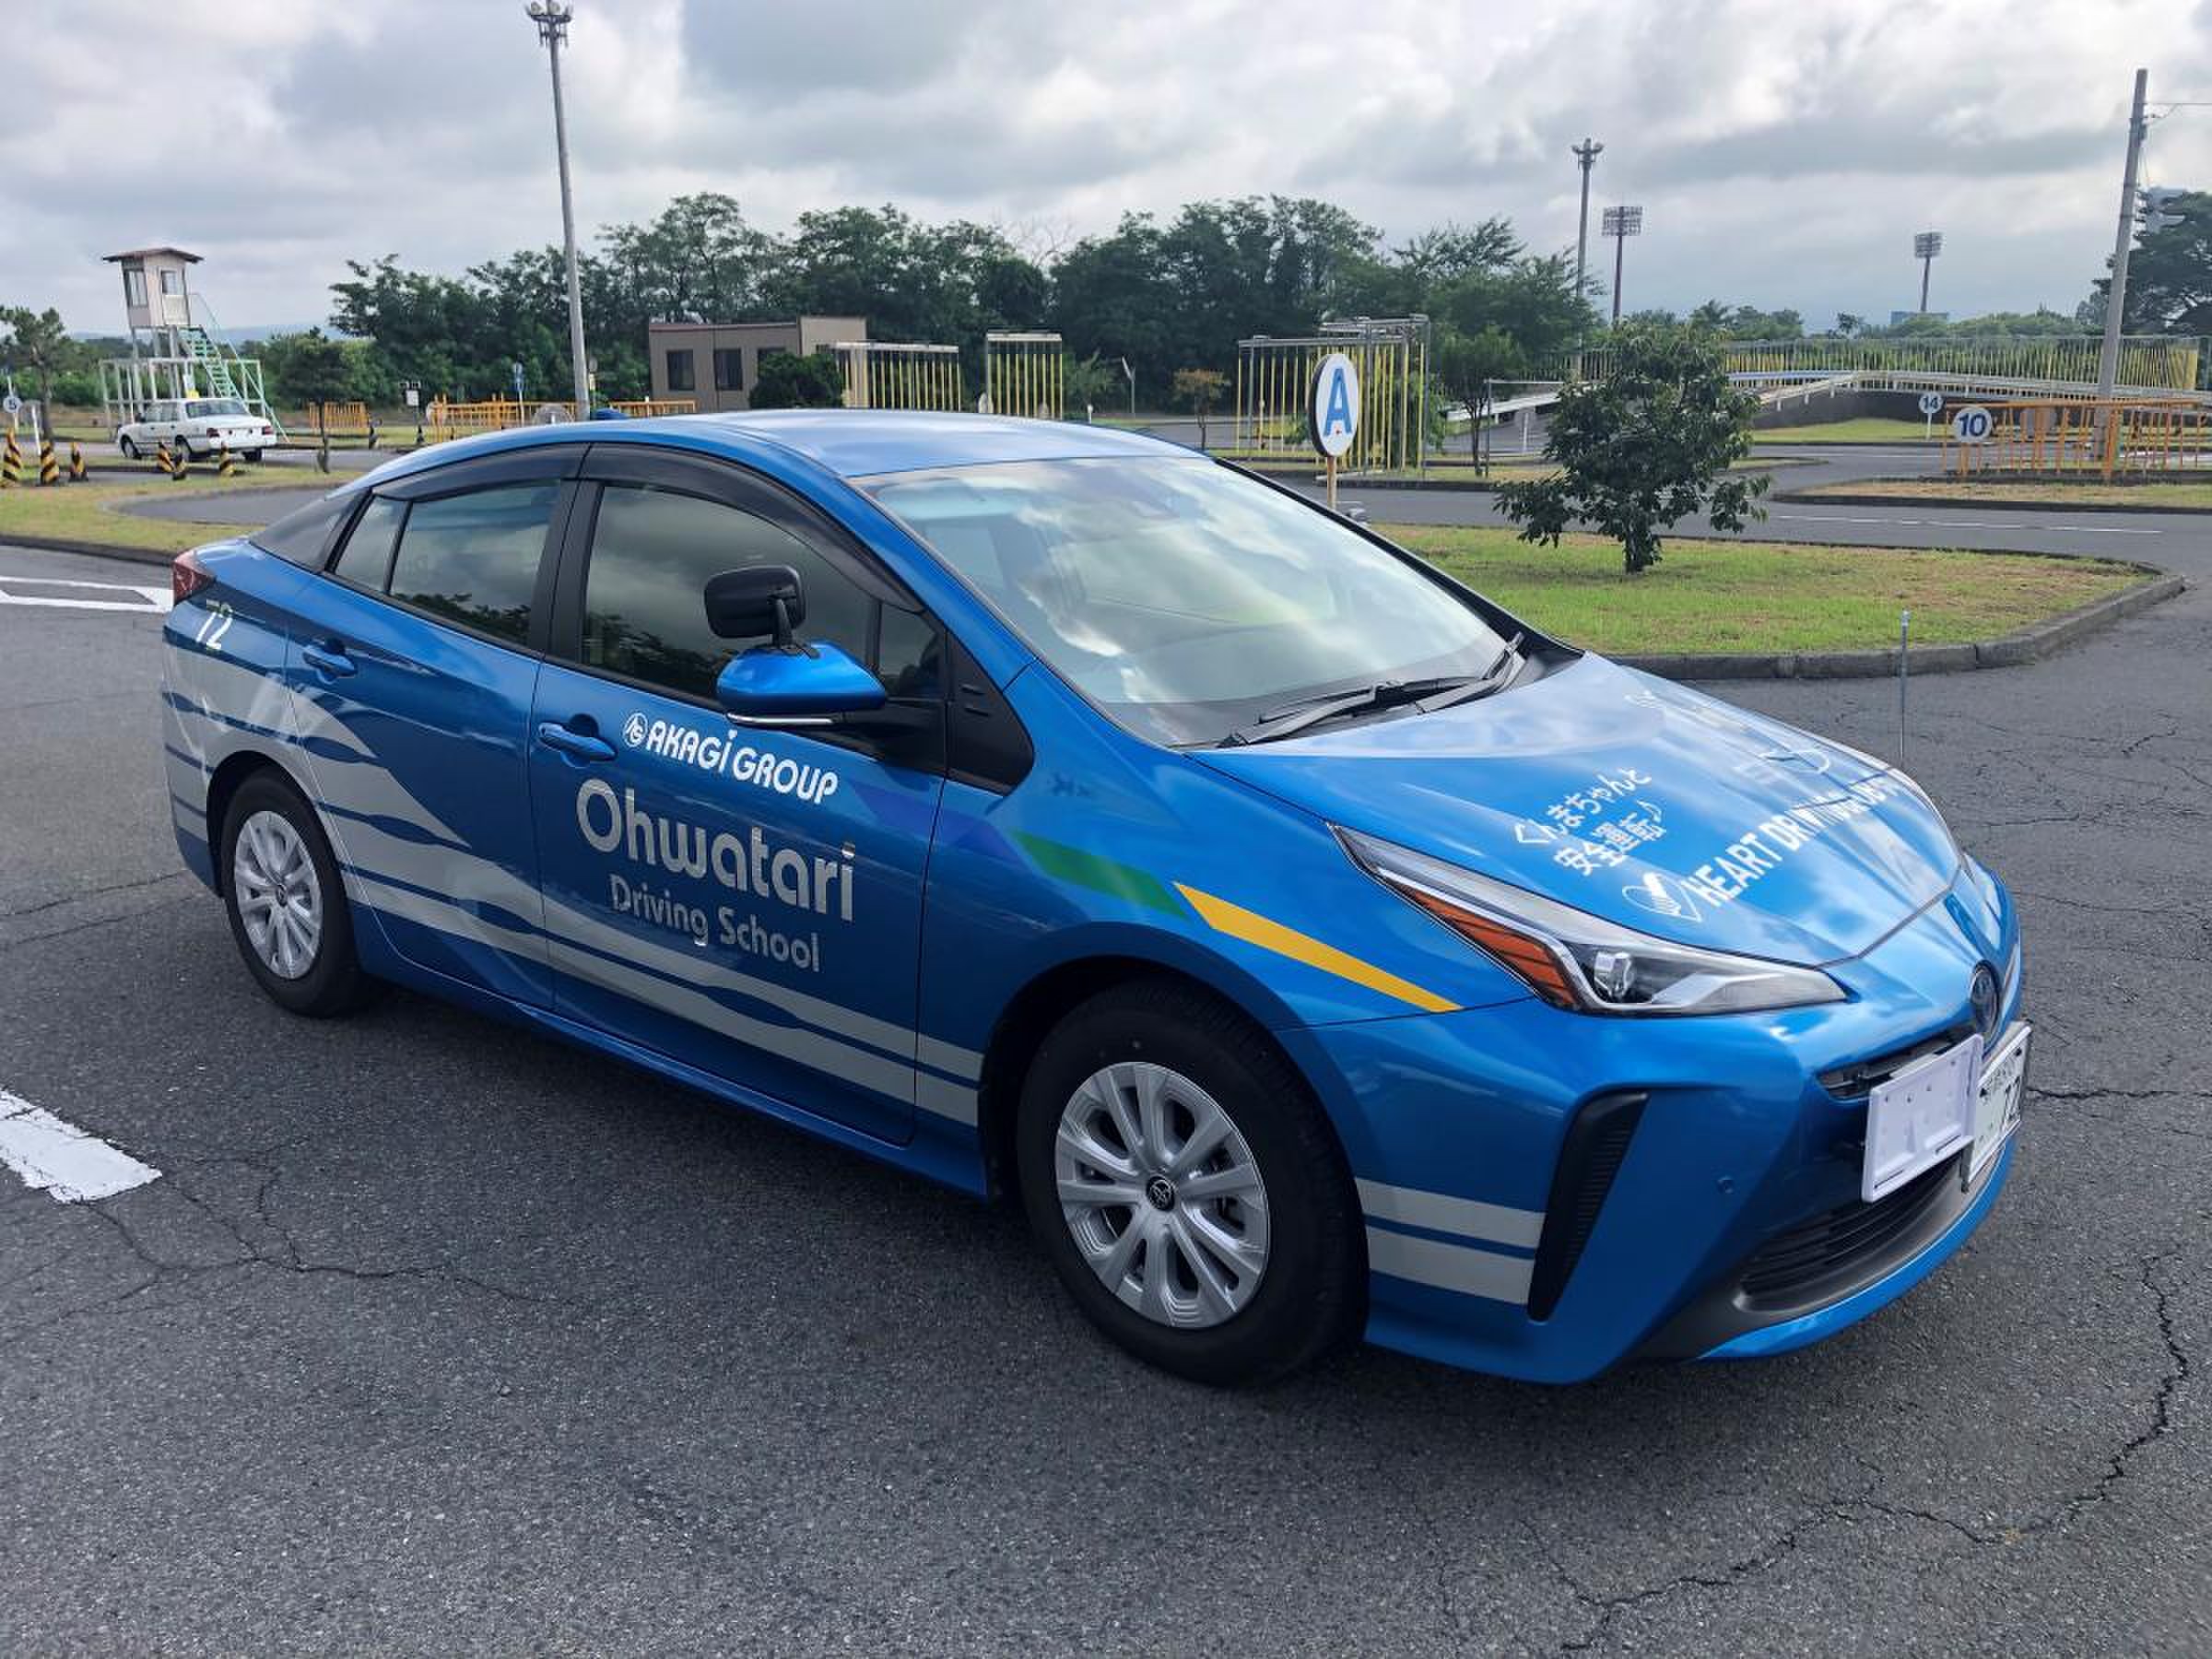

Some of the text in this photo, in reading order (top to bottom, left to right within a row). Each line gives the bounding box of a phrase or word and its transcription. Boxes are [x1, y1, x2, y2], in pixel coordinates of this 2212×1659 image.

[1323, 368, 1353, 437] A
[1923, 395, 1939, 409] 14
[1959, 412, 1988, 437] 10
[196, 599, 233, 650] 72
[733, 747, 838, 804] GROUP
[576, 778, 855, 922] Ohwatari
[1680, 831, 1783, 907] HEART
[609, 874, 819, 972] Driving School
